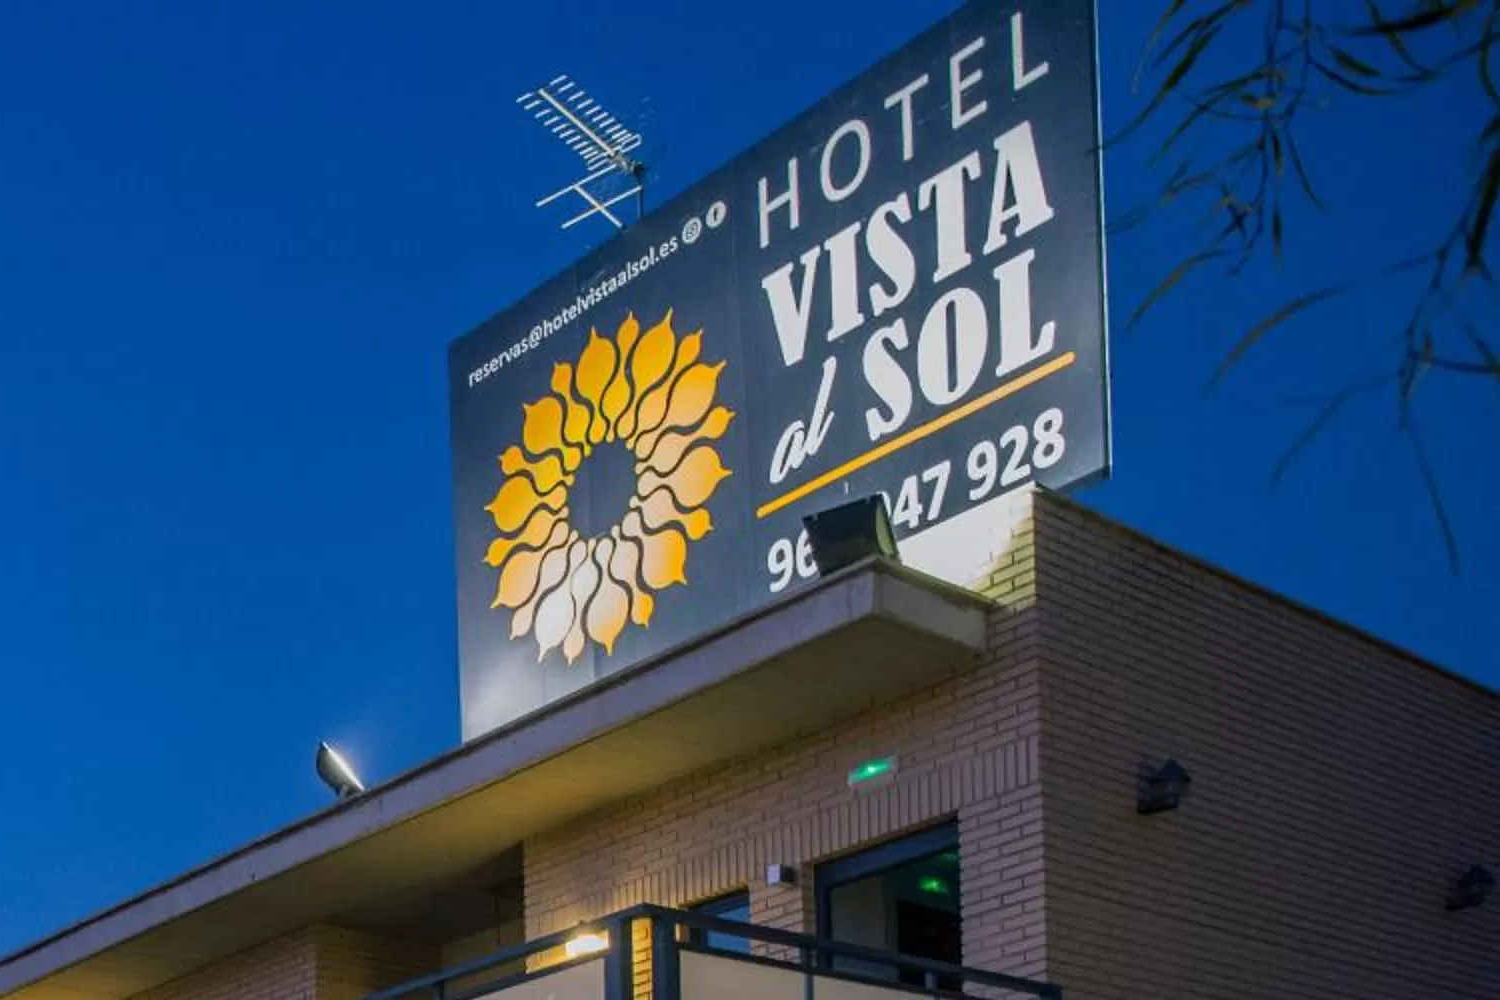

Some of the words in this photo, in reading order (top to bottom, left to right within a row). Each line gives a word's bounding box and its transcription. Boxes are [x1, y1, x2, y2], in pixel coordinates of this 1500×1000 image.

[758, 12, 1049, 248] HOTEL
[762, 120, 1055, 366] VISTA
[468, 235, 678, 388] reservas@hotelvistaalsol.es
[769, 356, 837, 484] al
[863, 249, 1055, 441] SOL
[767, 527, 820, 593] 96
[882, 460, 950, 528] 47
[967, 408, 1065, 500] 928
